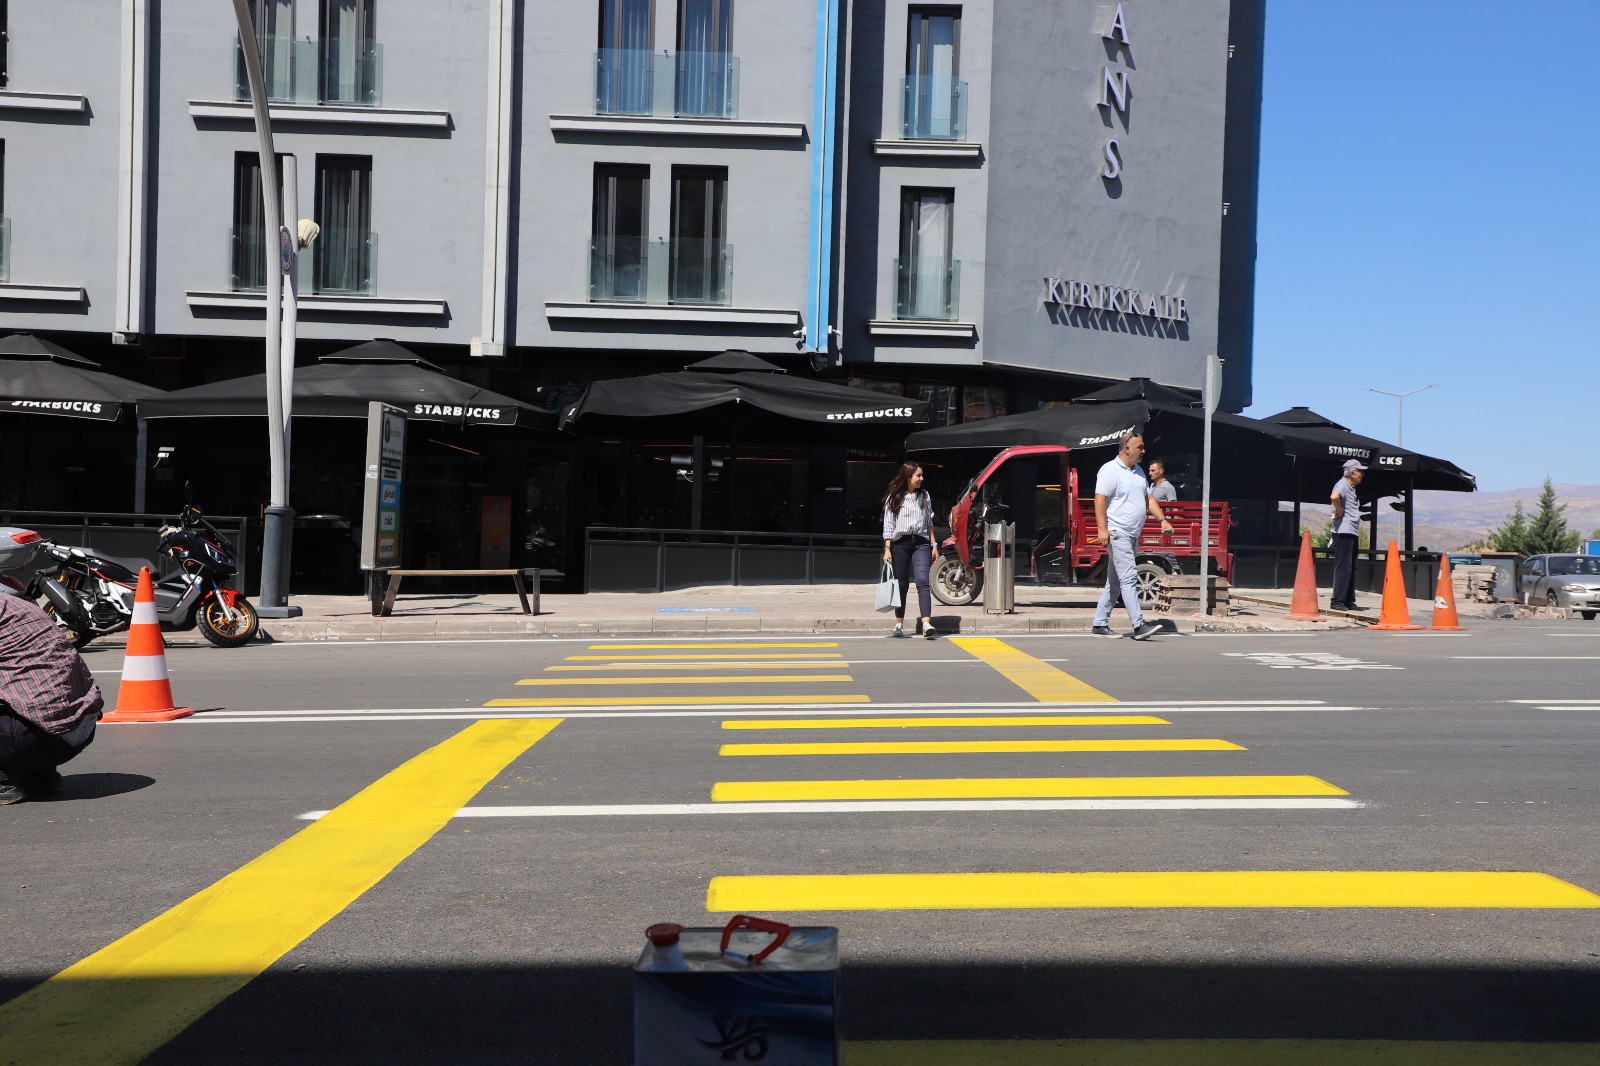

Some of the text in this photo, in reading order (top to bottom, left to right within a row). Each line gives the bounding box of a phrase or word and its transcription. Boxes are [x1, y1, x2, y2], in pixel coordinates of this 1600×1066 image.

[1044, 277, 1188, 321] KIRIKKALE
[826, 407, 913, 420] STARBUCKS
[1328, 445, 1371, 459] STARBUCKS
